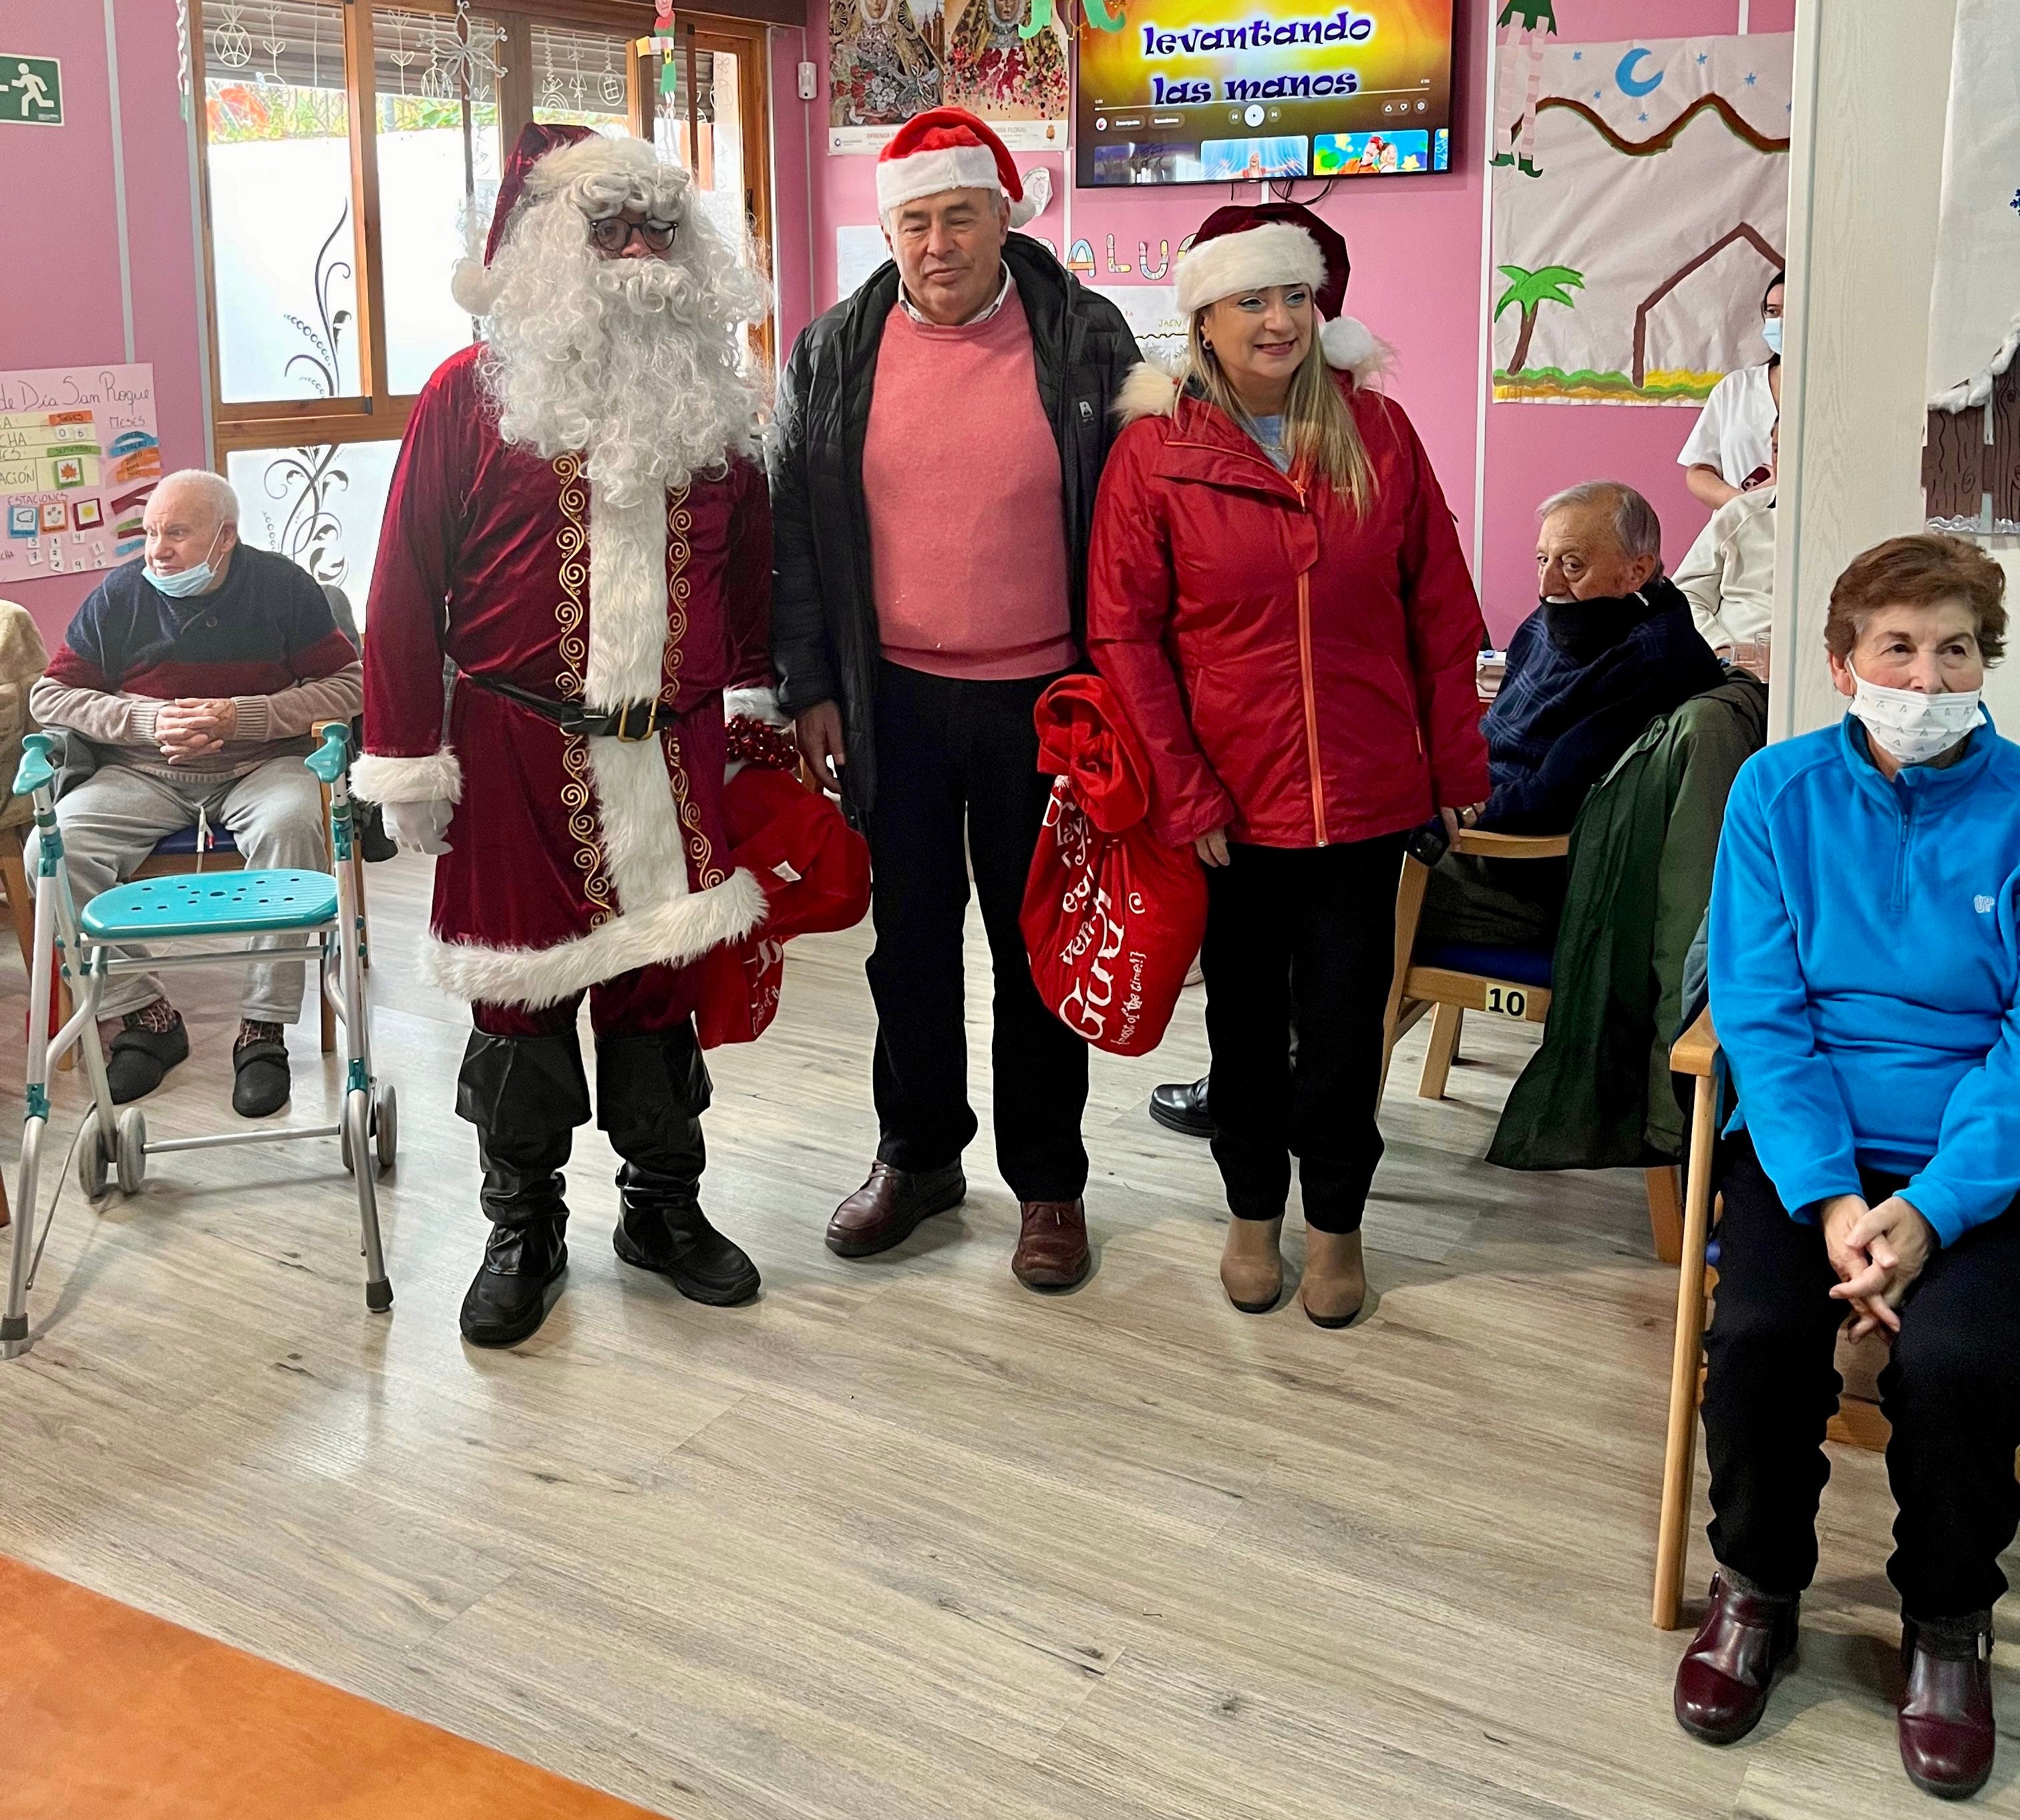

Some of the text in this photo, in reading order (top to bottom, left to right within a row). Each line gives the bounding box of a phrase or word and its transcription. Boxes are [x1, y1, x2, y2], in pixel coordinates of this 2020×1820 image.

[1144, 11, 1371, 55] levantando
[1154, 73, 1358, 106] las manos
[63, 375, 100, 405] San
[99, 371, 150, 416] Roque
[1488, 988, 1525, 1017] 10
